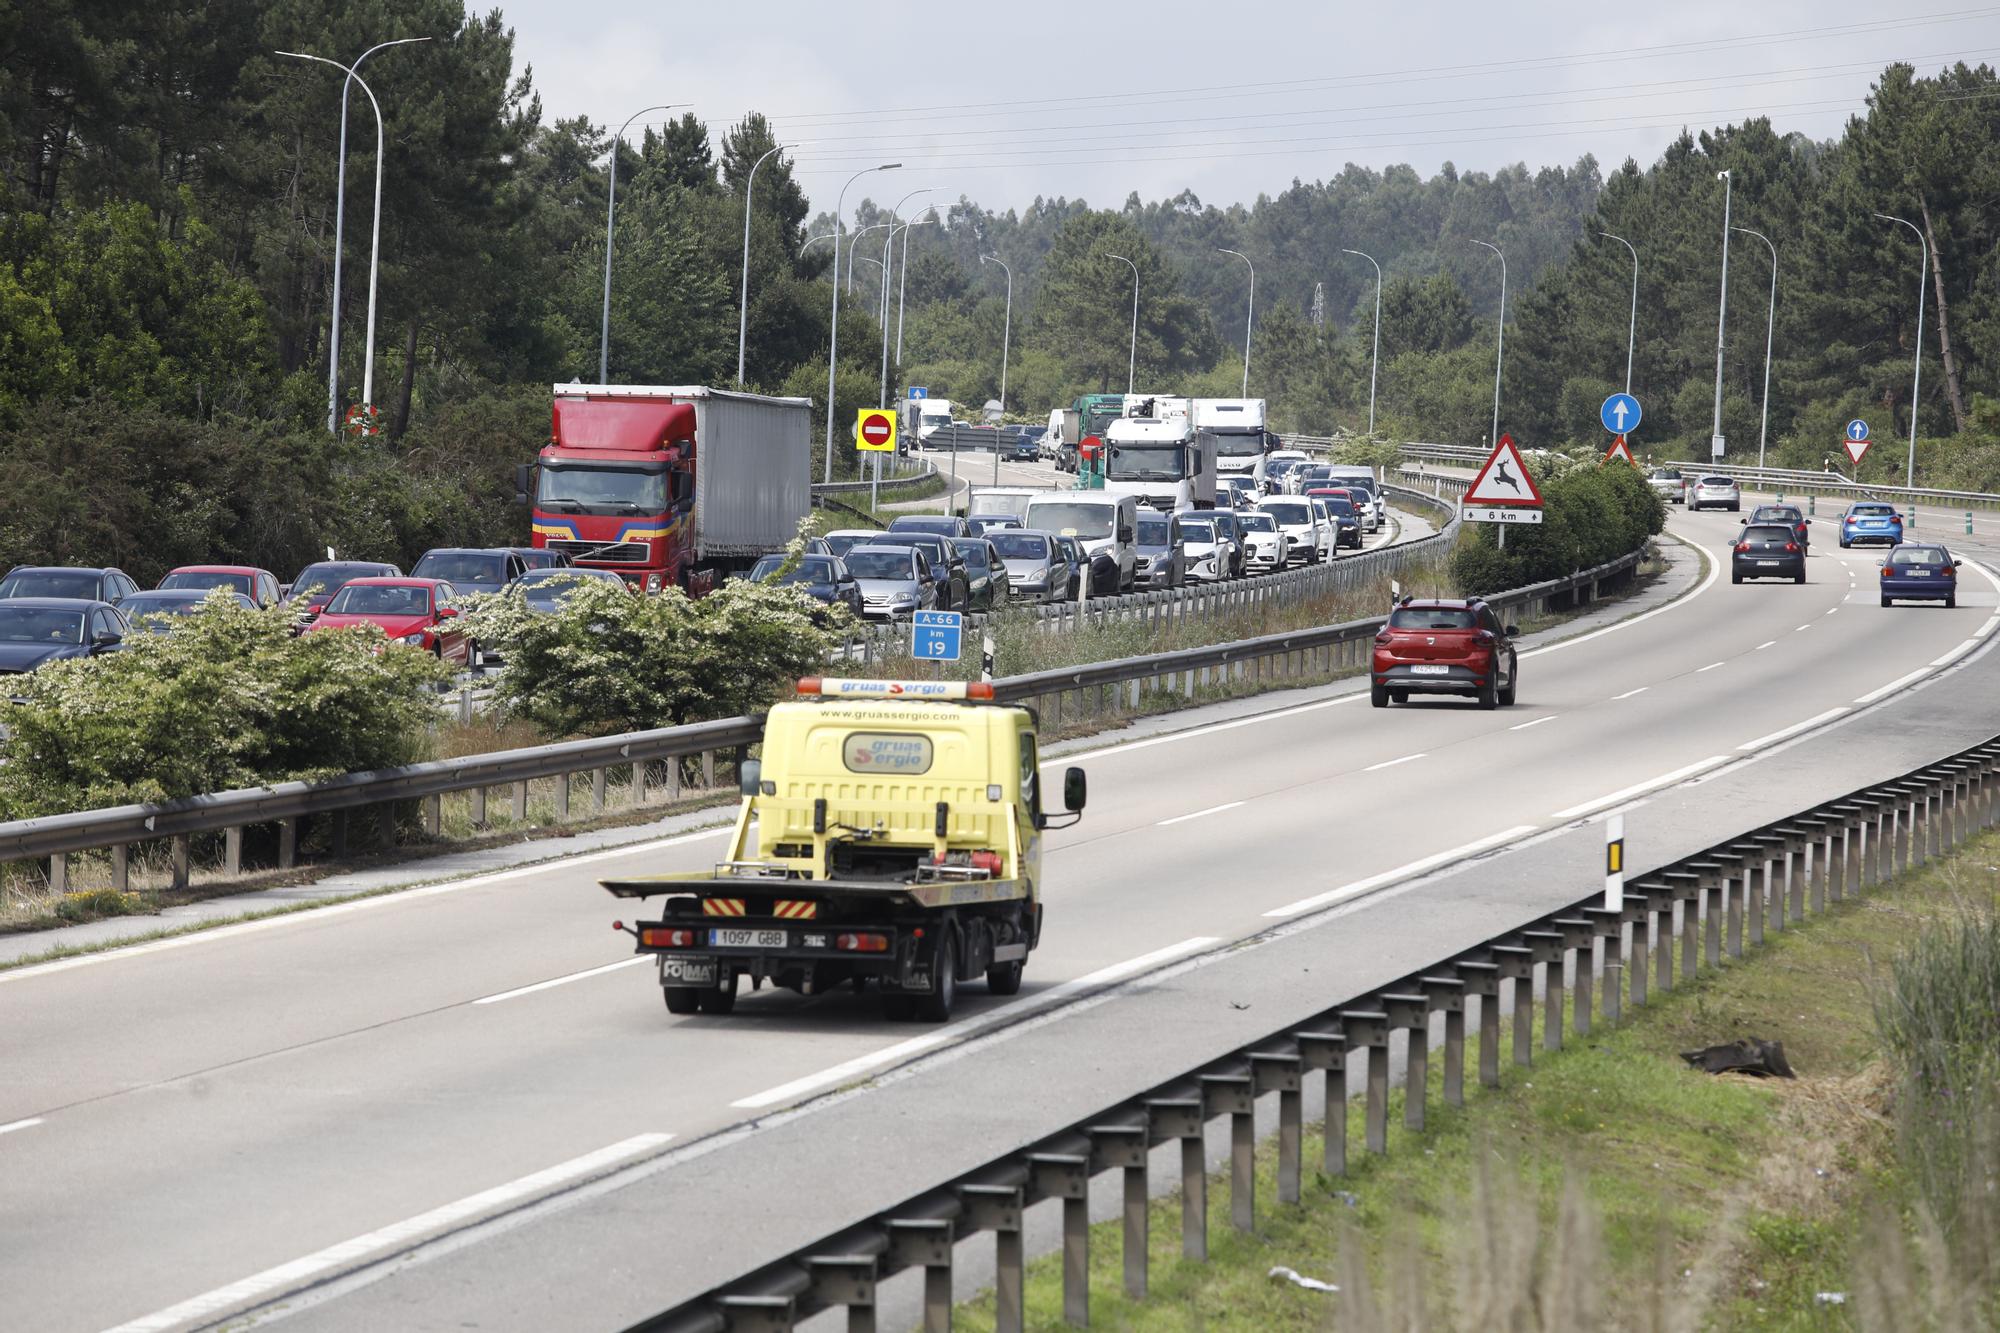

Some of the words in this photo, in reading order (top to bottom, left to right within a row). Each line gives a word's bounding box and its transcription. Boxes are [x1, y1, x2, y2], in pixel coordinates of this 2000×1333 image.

[1488, 511, 1495, 520] 6
[1501, 512, 1517, 521] km
[922, 613, 953, 625] A-66
[930, 629, 945, 638] km
[927, 641, 946, 655] 19
[841, 682, 886, 693] gruas
[888, 683, 946, 695] Sergio
[819, 708, 961, 722] www.gruassergio.com
[871, 740, 922, 753] gruas
[853, 747, 922, 768] Sergio
[723, 930, 752, 945] 1097
